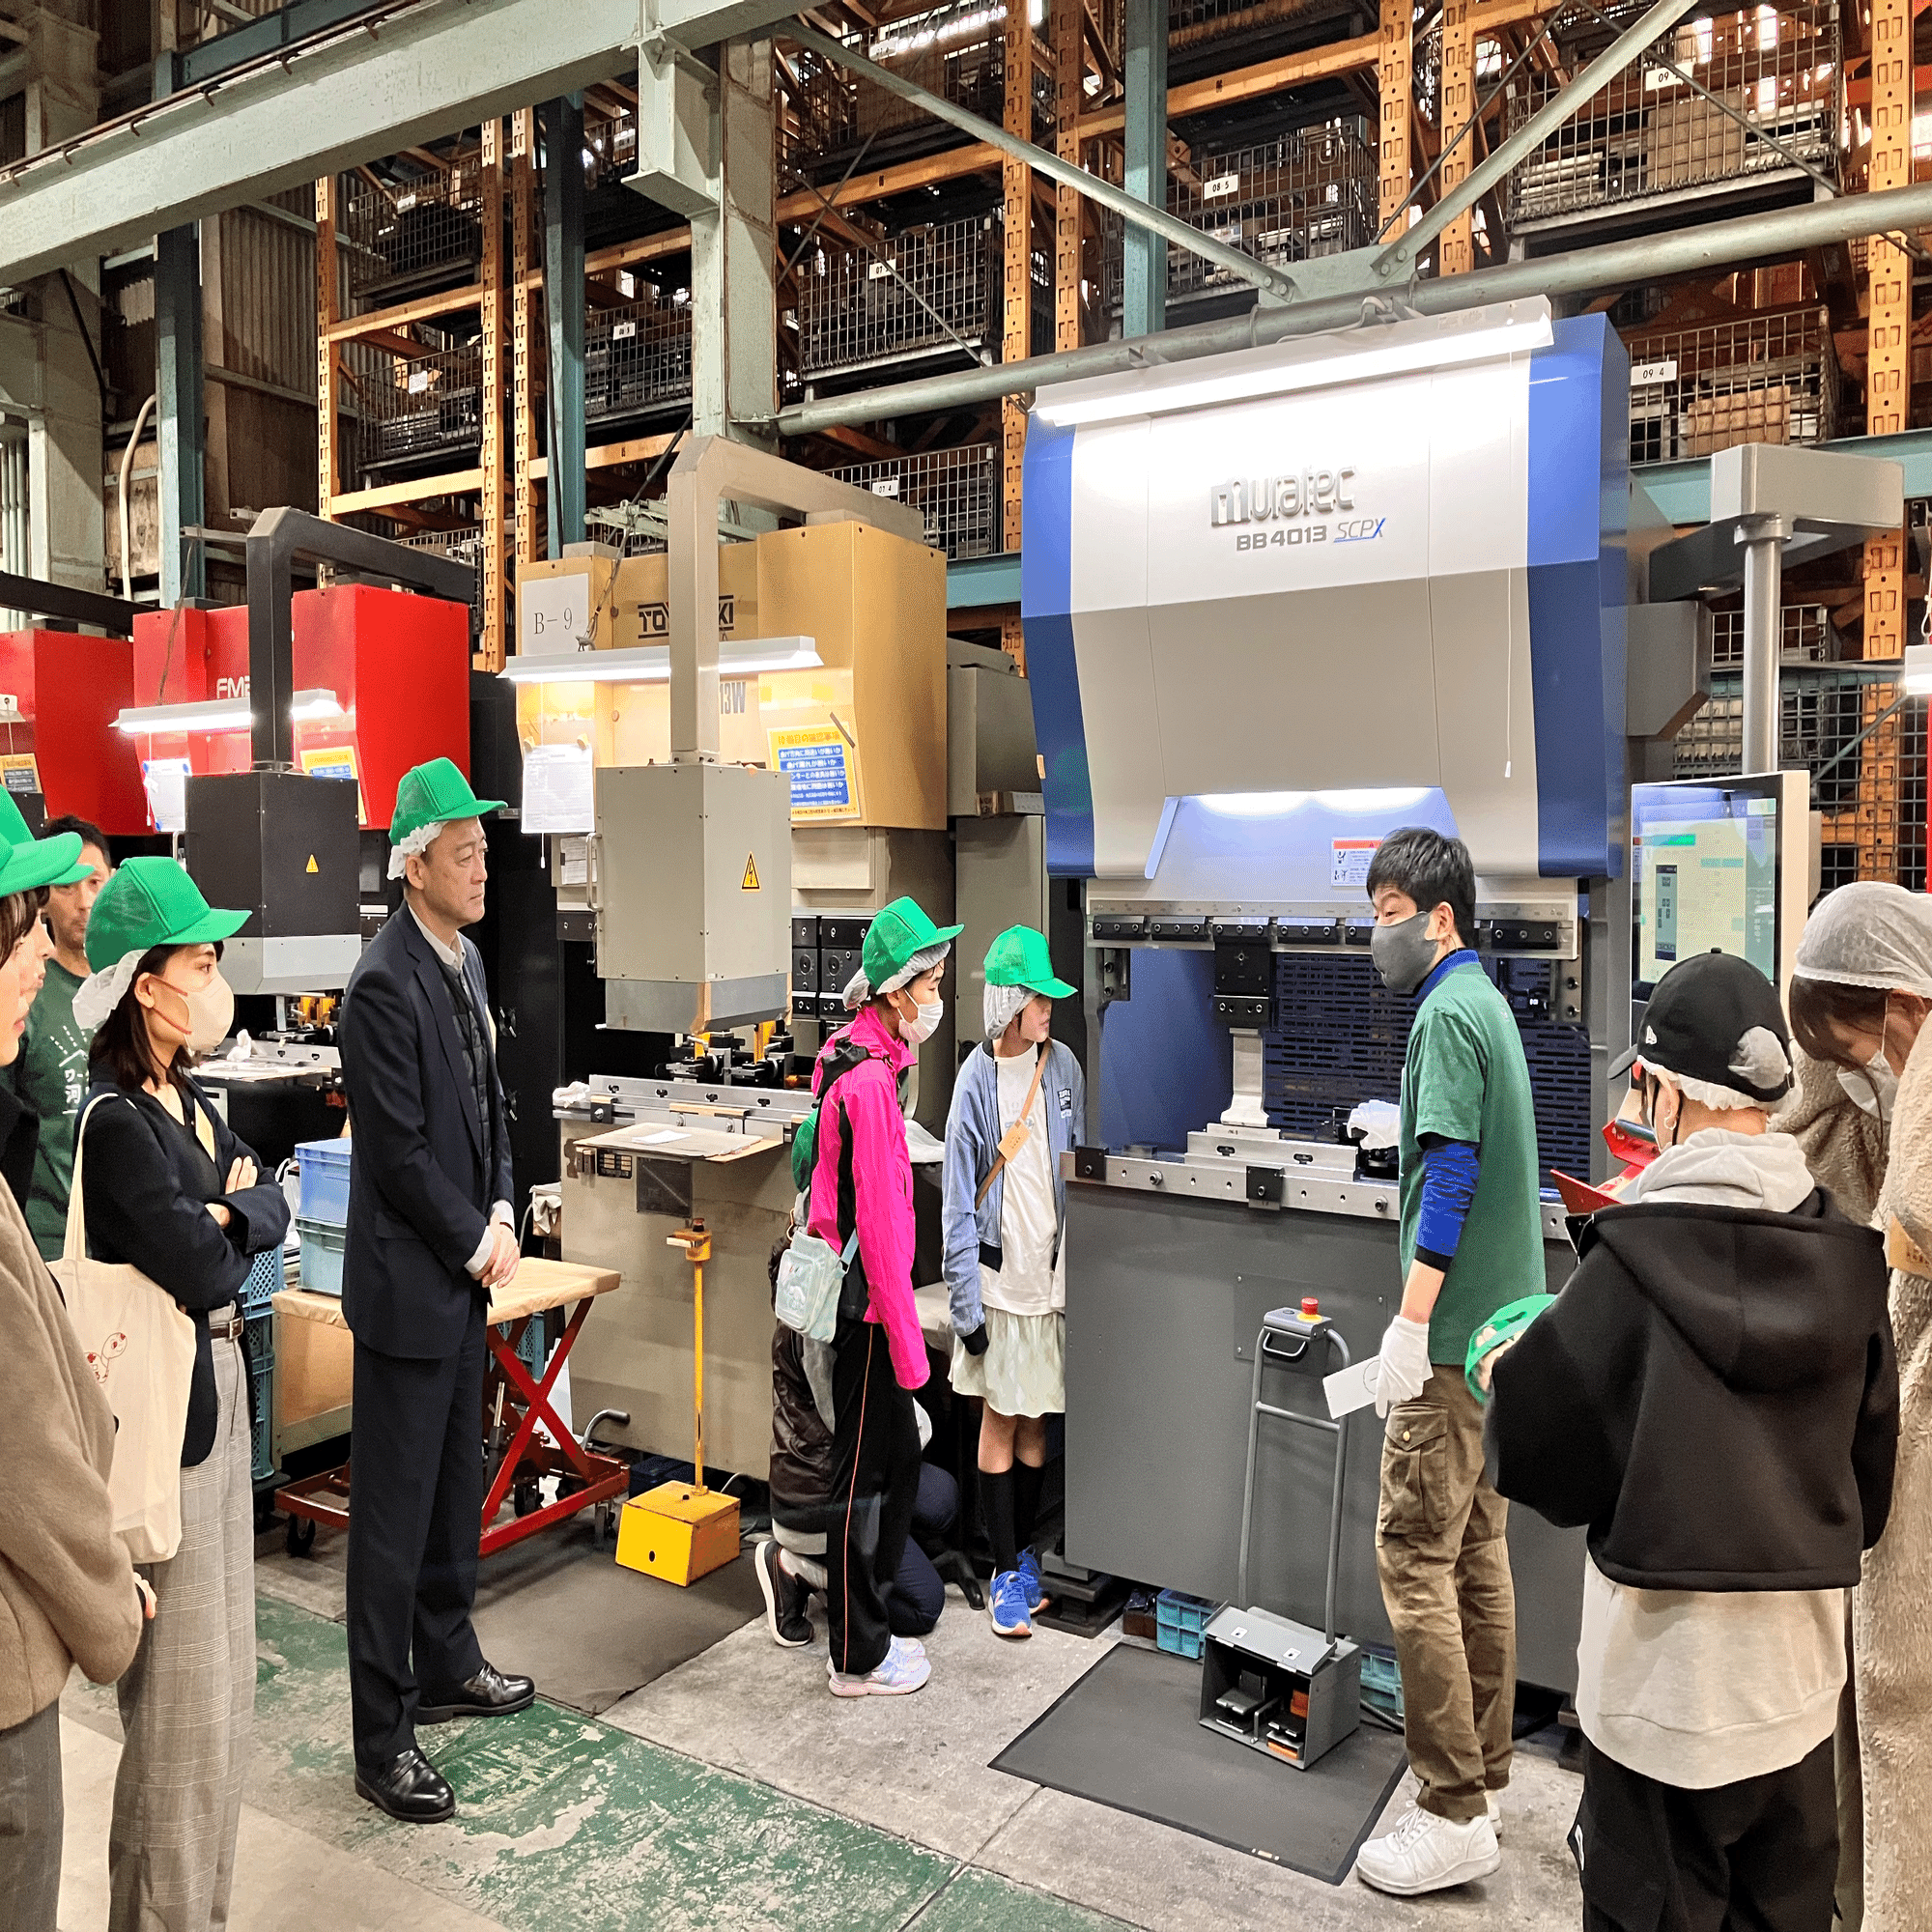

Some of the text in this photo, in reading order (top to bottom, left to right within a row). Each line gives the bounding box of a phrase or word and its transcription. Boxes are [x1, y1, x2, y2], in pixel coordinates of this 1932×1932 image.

[1659, 71, 1669, 83] 09
[1212, 181, 1230, 192] 08 5
[1642, 367, 1664, 380] 09 4
[879, 485, 886, 494] 07
[1236, 517, 1386, 552] BB4013 SCPX
